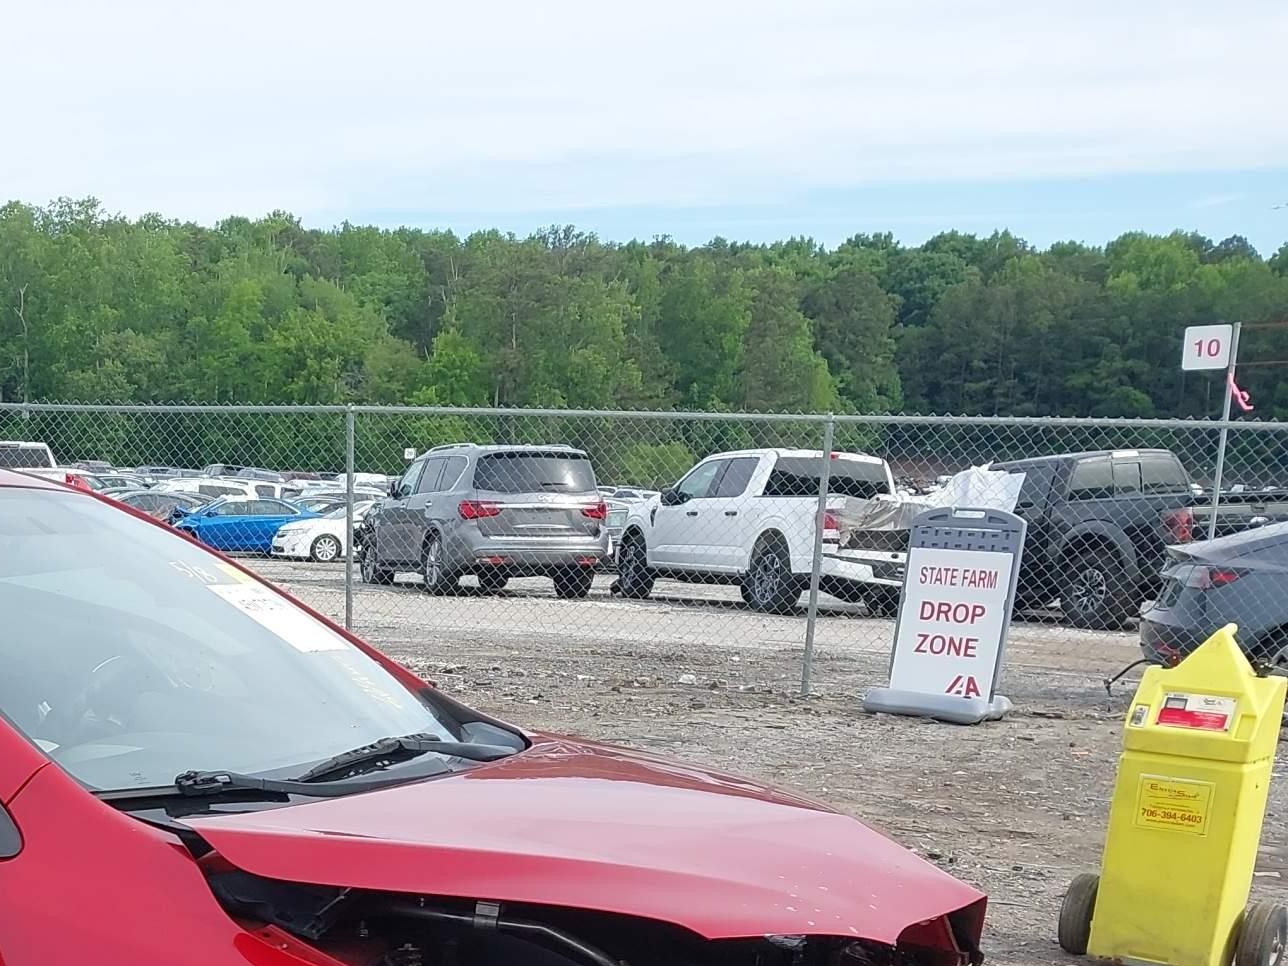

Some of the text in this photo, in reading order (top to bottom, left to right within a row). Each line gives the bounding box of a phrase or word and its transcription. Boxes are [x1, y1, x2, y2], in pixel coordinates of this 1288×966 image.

[1194, 339, 1221, 357] 10
[919, 566, 999, 589] STATE FARM
[919, 601, 986, 625] DROP
[914, 633, 980, 658] ZONE
[1141, 807, 1203, 824] 706-394-6403
